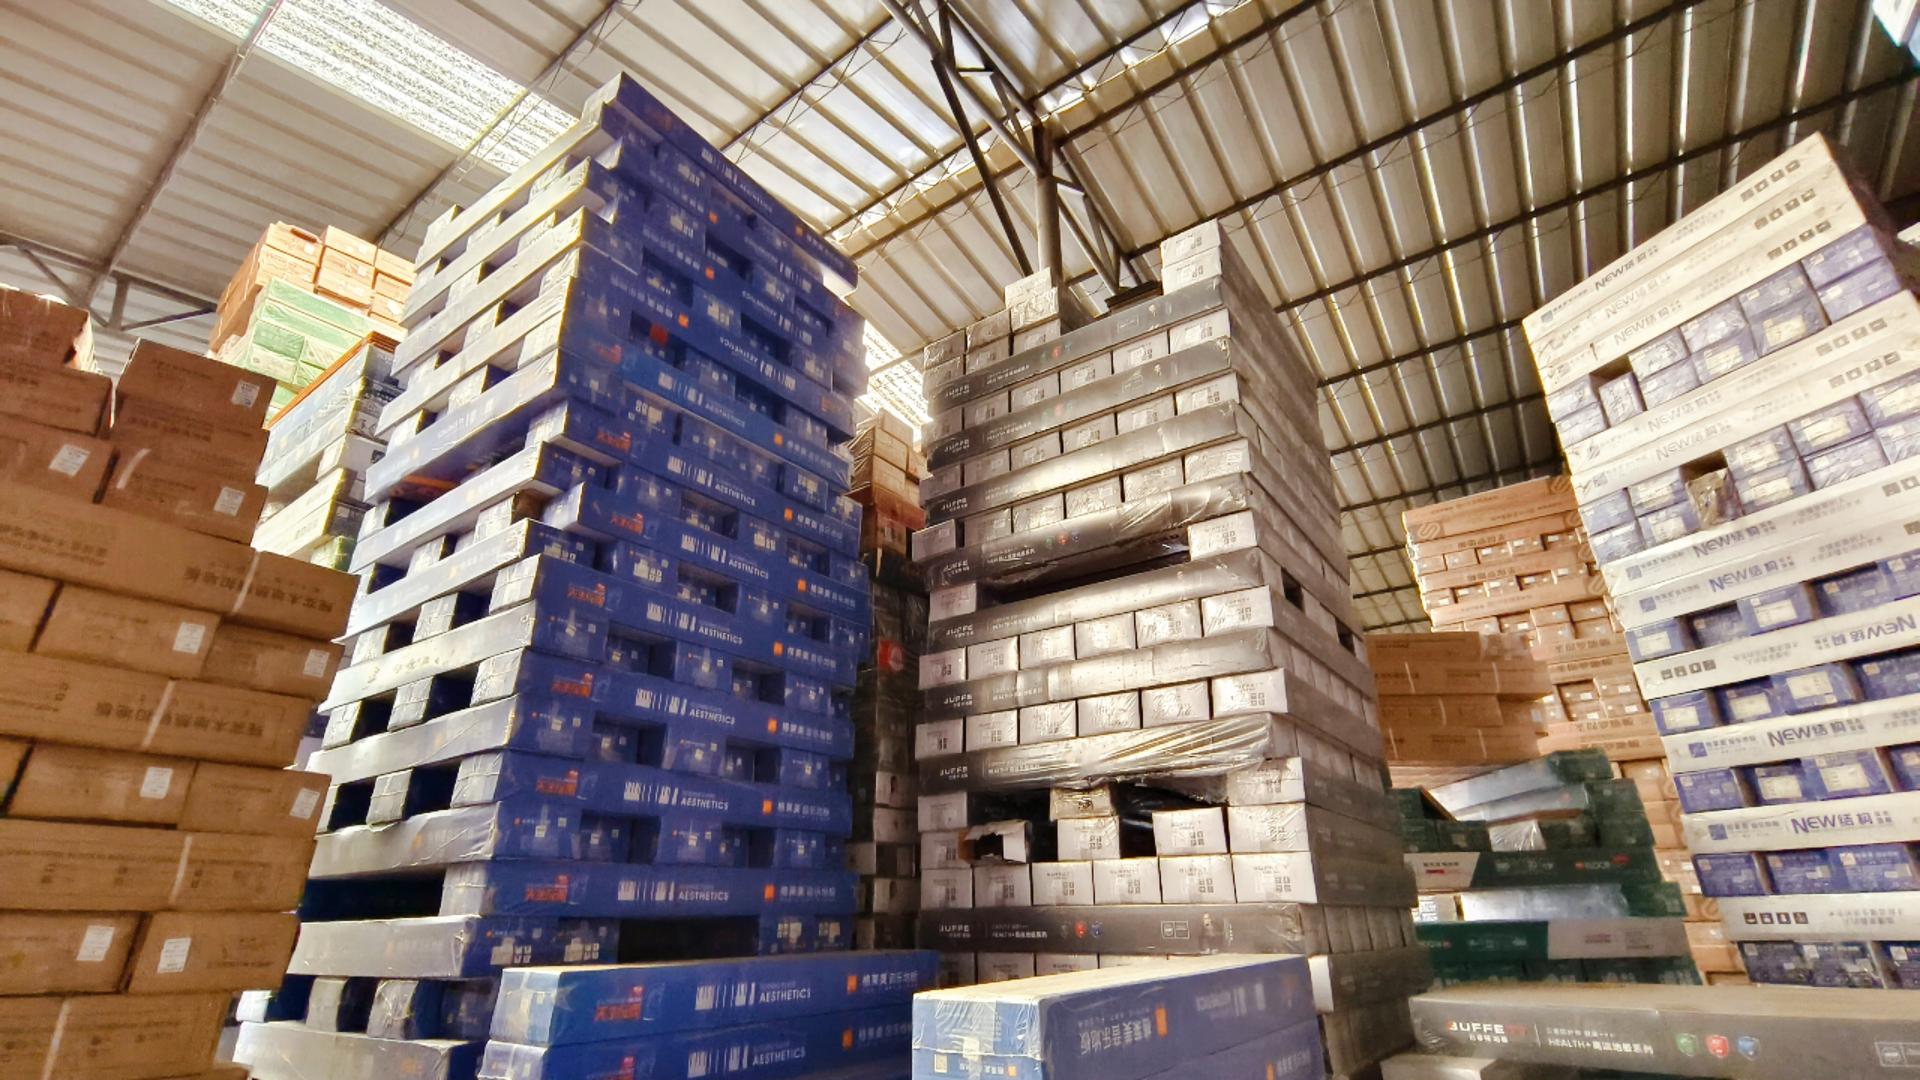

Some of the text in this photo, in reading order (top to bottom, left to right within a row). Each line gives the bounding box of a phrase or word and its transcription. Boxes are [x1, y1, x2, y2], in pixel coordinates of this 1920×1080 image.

[715, 483, 756, 506] AESTHETICS
[728, 559, 769, 580] AESTHETICS
[699, 626, 743, 645] AESTHETICS
[689, 708, 736, 726] AESTHETICS
[680, 797, 729, 811] AESTHETICS
[678, 890, 729, 902] AESTHETICS
[758, 988, 811, 1003] AESTHETICS
[752, 1046, 806, 1067] AESTHETICS
